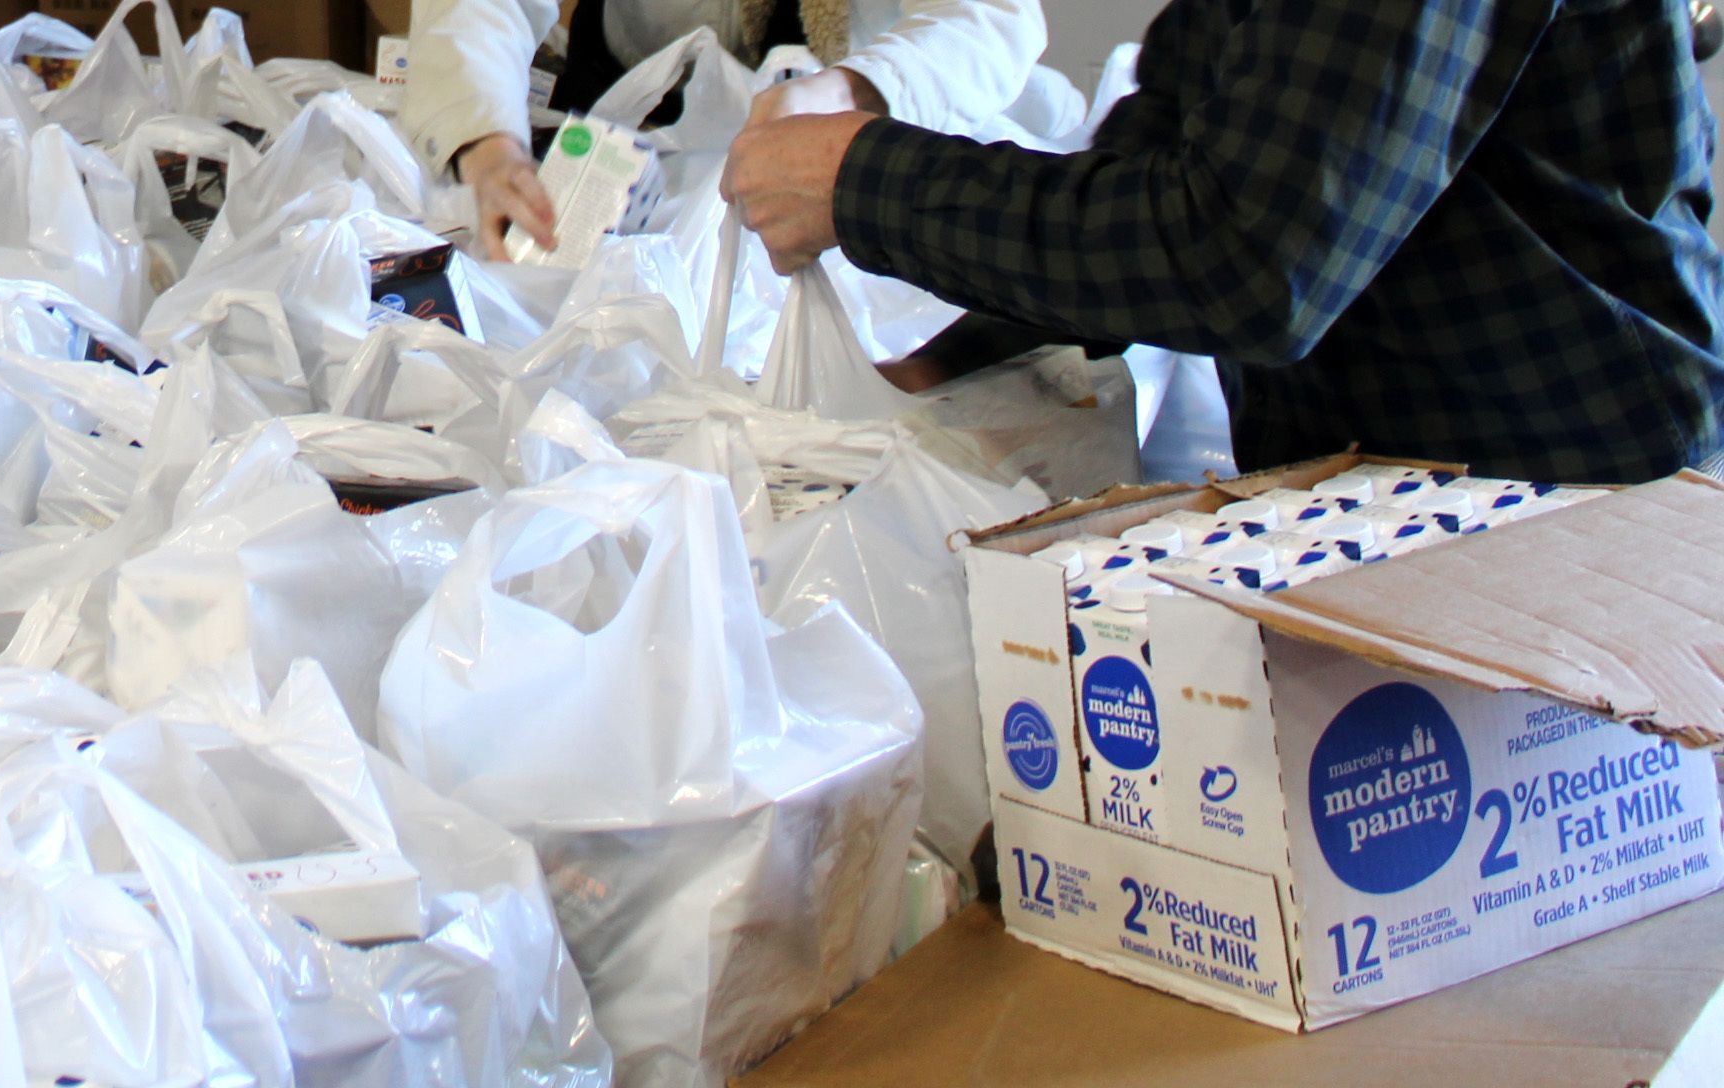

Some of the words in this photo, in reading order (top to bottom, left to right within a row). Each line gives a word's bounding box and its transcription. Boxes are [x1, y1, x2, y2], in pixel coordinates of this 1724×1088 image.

[1088, 698, 1152, 724] modern
[1099, 718, 1156, 747] pantry
[1508, 723, 1565, 756] PACKAGED
[1565, 719, 1577, 736] IN
[1577, 714, 1599, 732] THE
[1329, 746, 1395, 779] marcel's
[1110, 774, 1140, 803] 2%
[1324, 759, 1450, 816] modern
[1102, 798, 1154, 830] MILK
[1200, 802, 1220, 819] Easy
[1220, 807, 1244, 822] Open
[1201, 816, 1226, 831] Screw
[1347, 789, 1458, 853] pantry
[1475, 776, 1546, 879] 2%
[1548, 739, 1680, 809] Reduced
[1557, 805, 1609, 854] Fat
[1616, 780, 1684, 833] Milk
[1012, 848, 1054, 907] 12
[1472, 881, 1531, 915] Vitamin
[1535, 873, 1547, 893] A
[1549, 869, 1561, 889] &
[1564, 864, 1575, 883] D
[1590, 850, 1613, 876] 2%
[1616, 834, 1665, 868] Milkfat
[1678, 817, 1705, 844] UHT
[1019, 897, 1055, 920] CARTONS
[1120, 876, 1165, 936] 2%
[1164, 891, 1257, 942] Reduced
[1533, 901, 1574, 927] Grade
[1578, 895, 1588, 912] A
[1602, 879, 1637, 904] Shelf
[1639, 864, 1680, 892] Stable
[1683, 852, 1710, 877] Milk
[1170, 921, 1205, 956] Fat
[1210, 935, 1259, 973] Milk
[1327, 914, 1381, 977] 12
[1420, 917, 1458, 936] CARTONS
[1119, 935, 1156, 959] Vitamin
[1209, 965, 1245, 989] Milkfat
[1389, 946, 1405, 961] NET
[1421, 939, 1431, 951] FL
[1432, 935, 1444, 946] OZ
[1332, 967, 1384, 994] CARTONS
